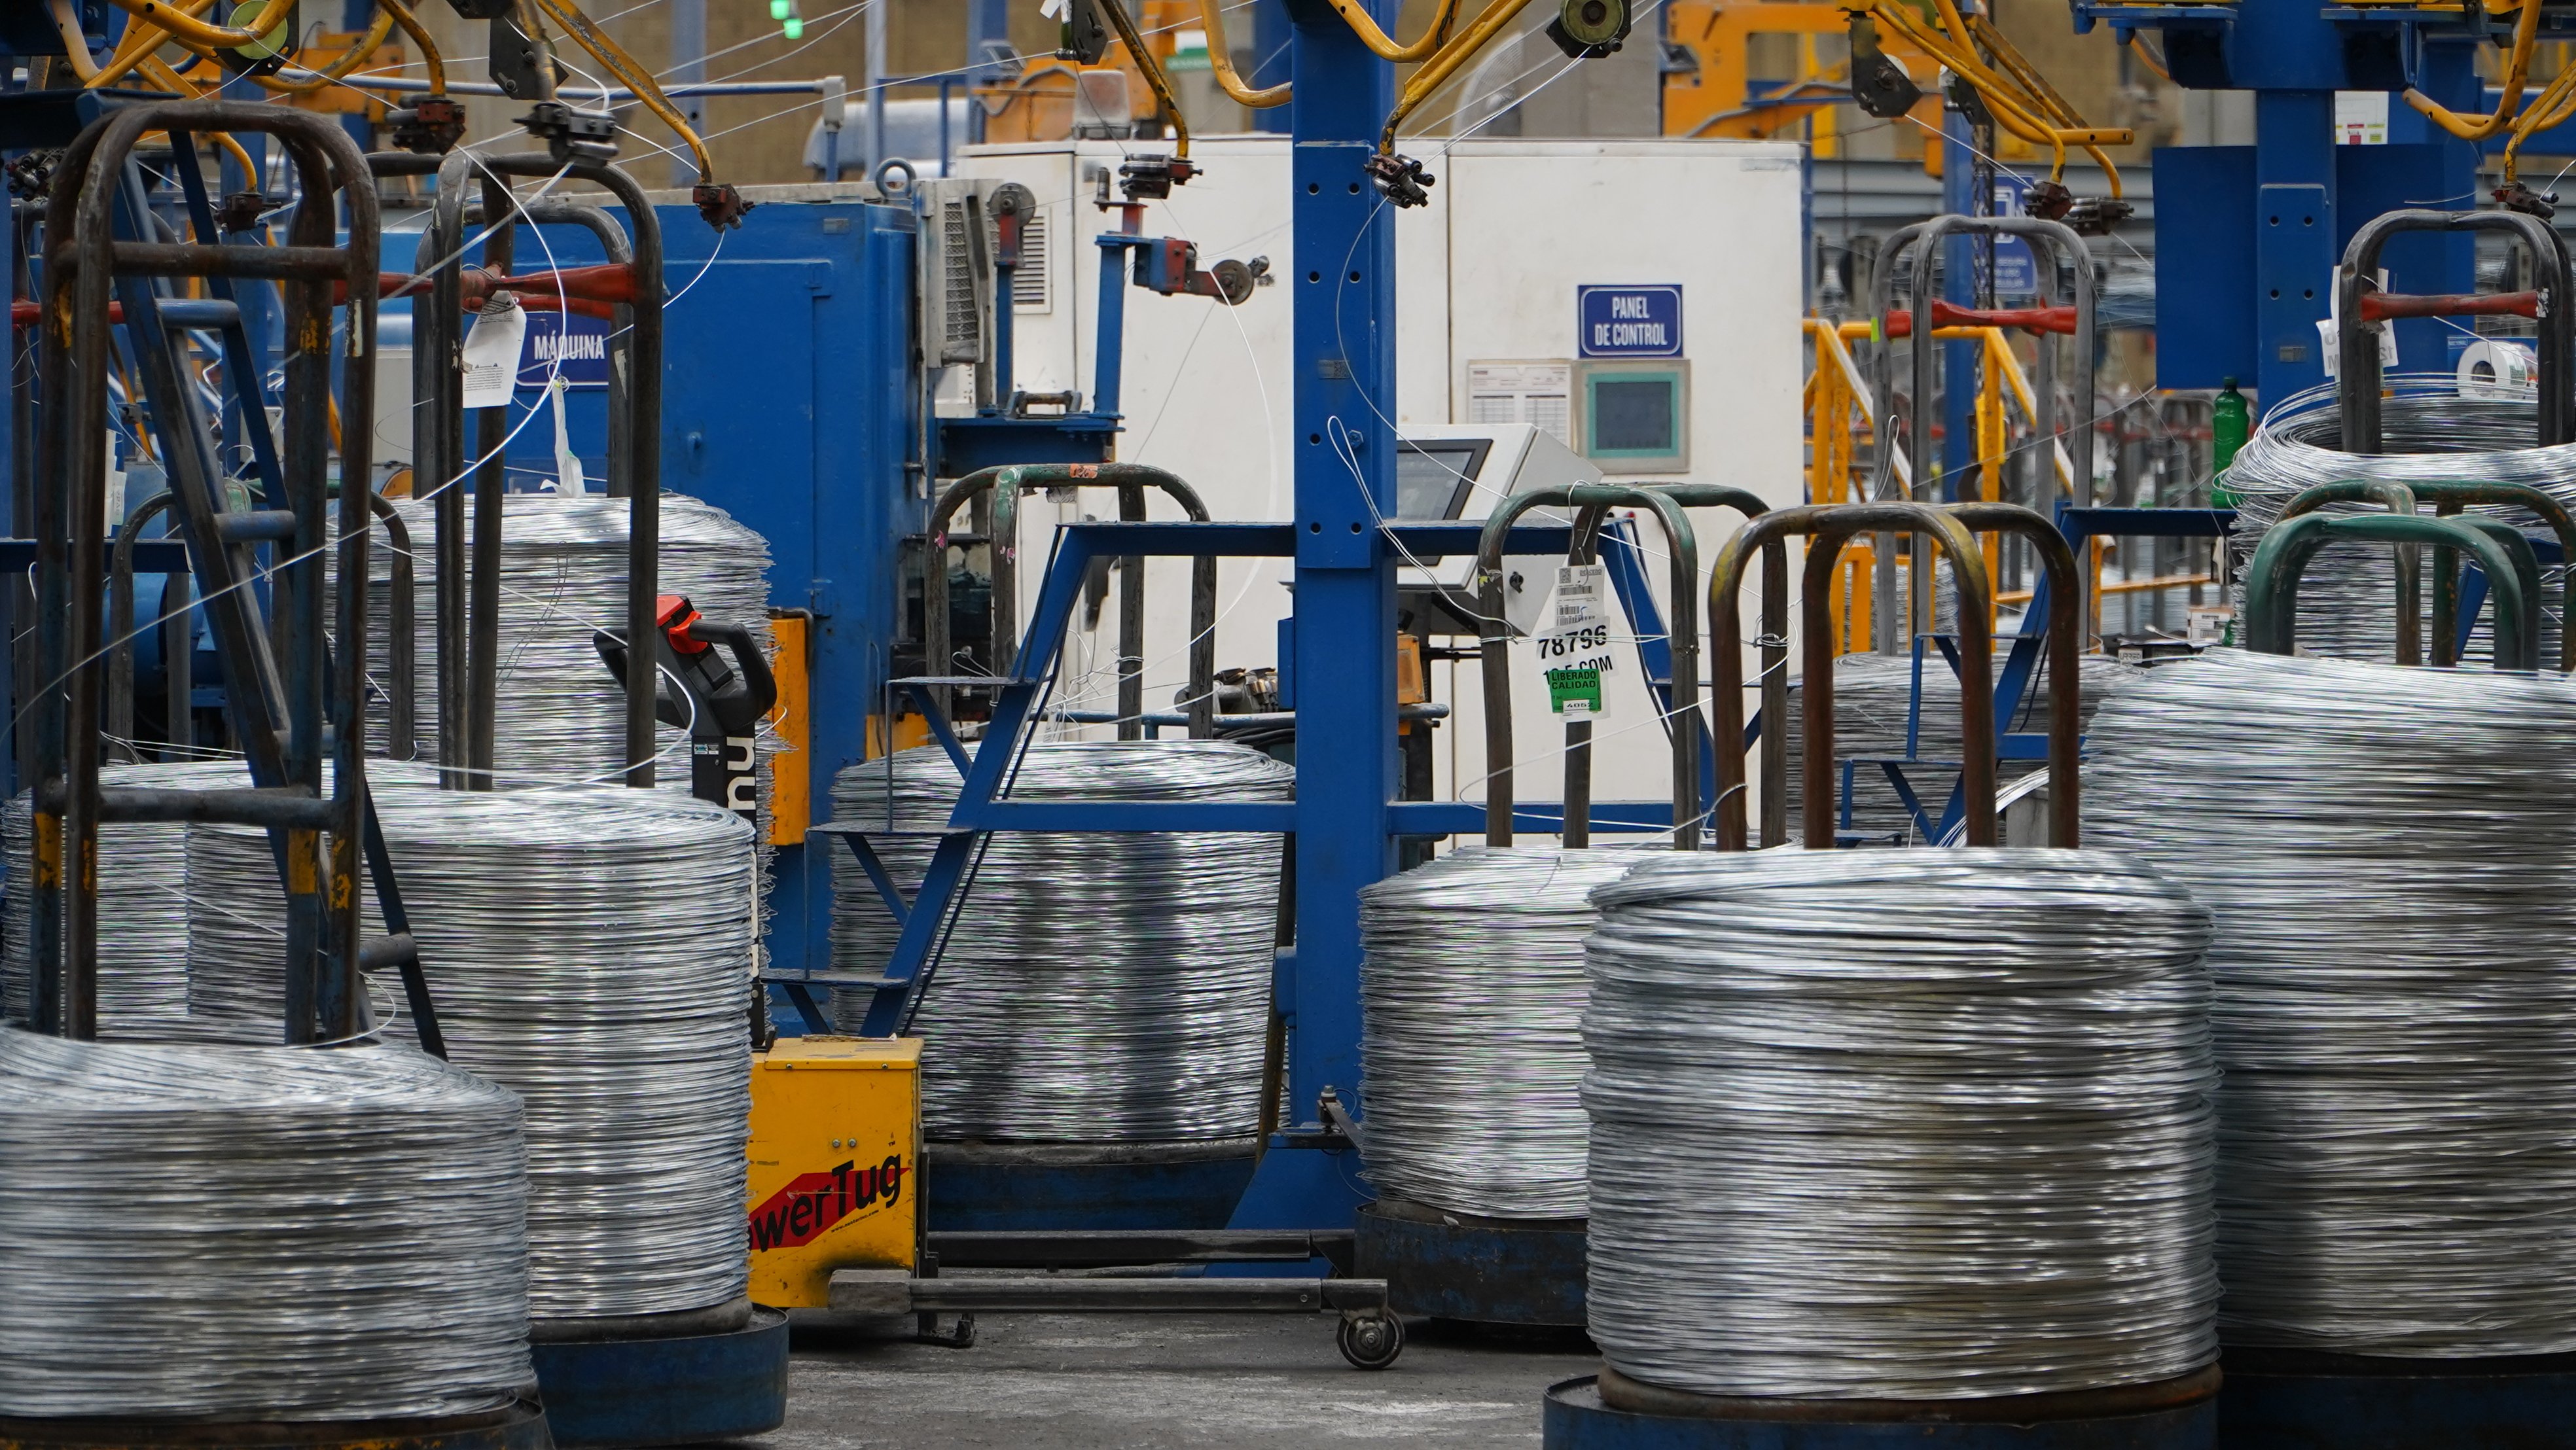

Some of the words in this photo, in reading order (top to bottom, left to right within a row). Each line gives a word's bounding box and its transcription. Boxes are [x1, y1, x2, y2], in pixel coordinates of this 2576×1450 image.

[1612, 296, 1650, 319] PANEL
[534, 330, 605, 360] MÁQUINA
[1594, 324, 1611, 345] DE
[1612, 323, 1668, 346] CONTROL
[1539, 625, 1607, 659] 78796
[1551, 671, 1596, 681] LIBERADO
[1551, 681, 1596, 690] CALIDAD
[749, 1154, 901, 1253] werTug
